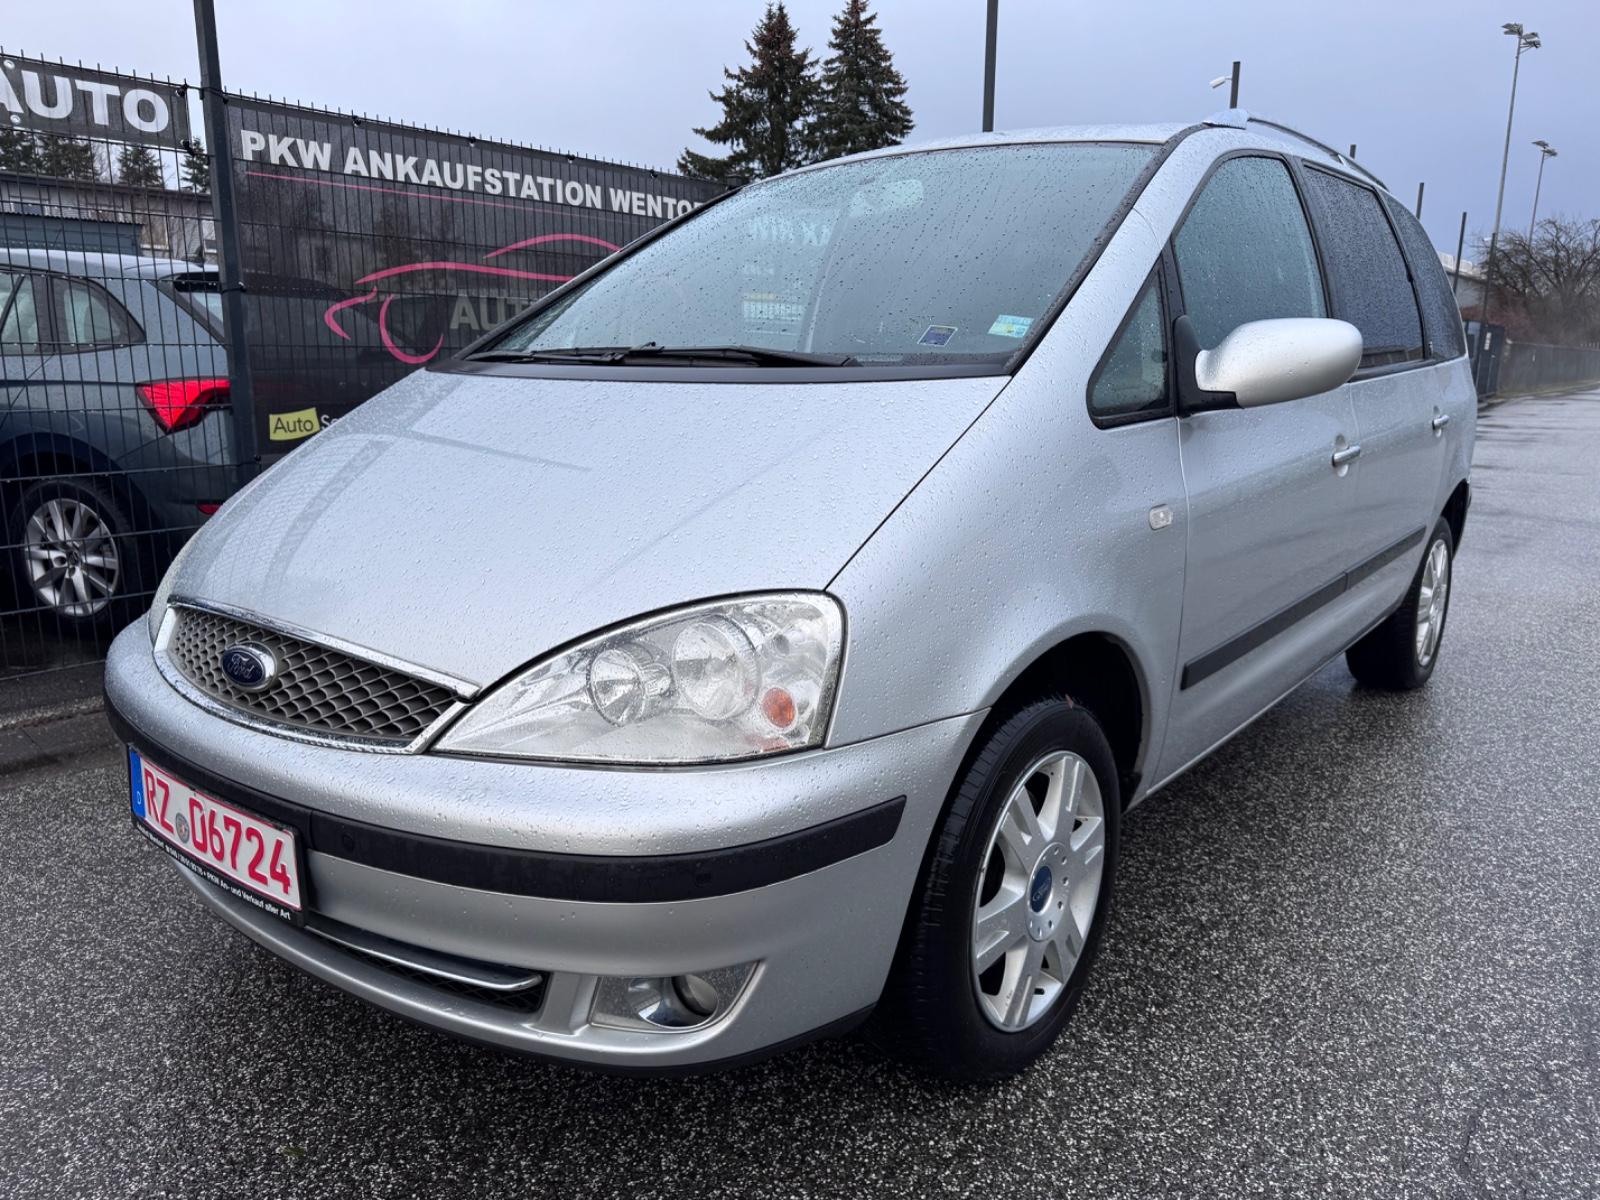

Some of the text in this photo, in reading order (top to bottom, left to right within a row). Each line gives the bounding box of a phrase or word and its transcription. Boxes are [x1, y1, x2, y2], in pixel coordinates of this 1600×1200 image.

[240, 129, 331, 171] PKW
[343, 146, 602, 210] ANKAUFSTATION
[449, 292, 540, 331] AUT
[273, 416, 314, 434] Auto
[144, 767, 291, 894] RZ 06724
